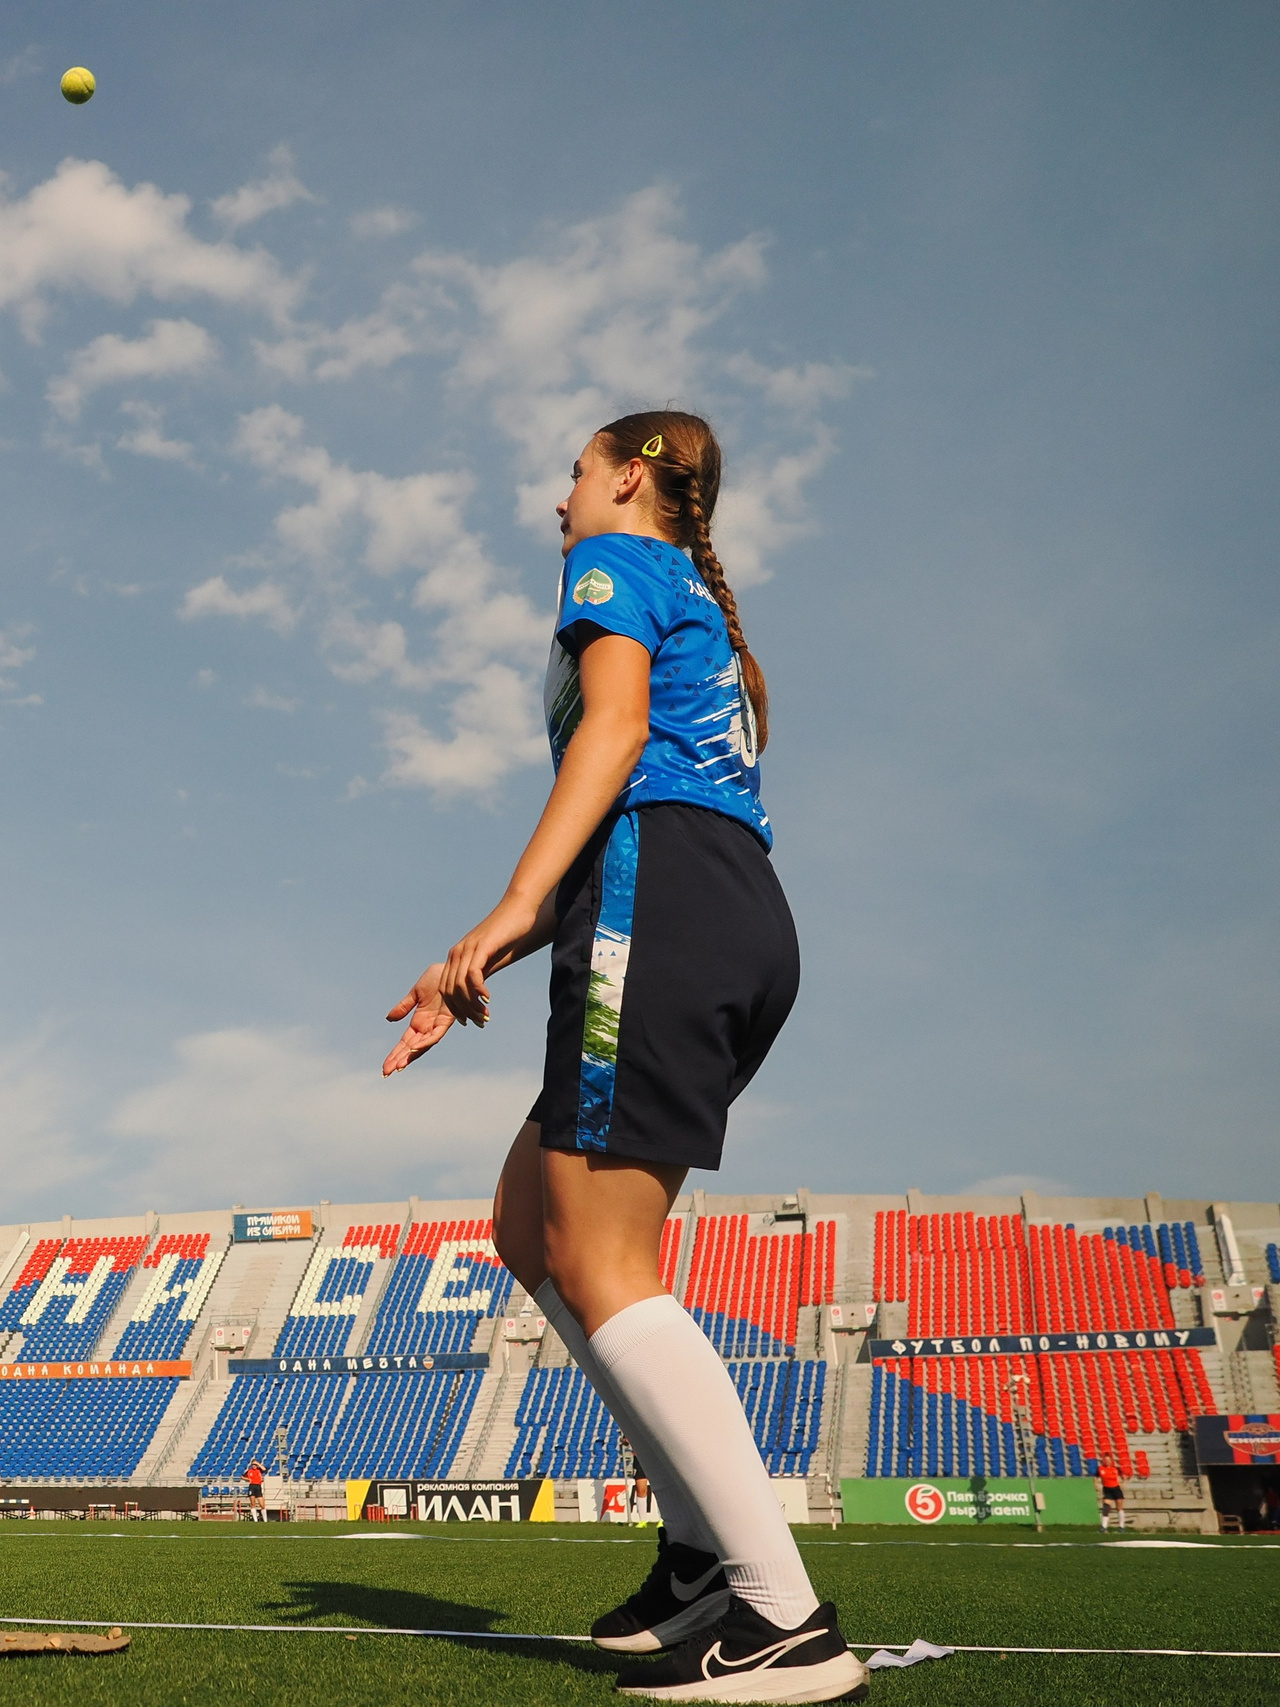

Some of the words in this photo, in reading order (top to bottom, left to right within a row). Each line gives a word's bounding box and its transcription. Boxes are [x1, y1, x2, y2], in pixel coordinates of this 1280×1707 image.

[246, 1214, 300, 1226] ПРЯМИКОМ
[246, 1226, 261, 1237] ИЗ
[262, 1224, 301, 1236] СИБИРИ
[891, 1338, 1001, 1355] ФУТБОЛ
[1019, 1331, 1191, 1351] ПО-НОВОМУ
[1, 1365, 49, 1377] ОДНА
[63, 1363, 154, 1375] КОМАНДА
[279, 1358, 331, 1373] ОДНА
[346, 1356, 417, 1370] МЕЧТА
[417, 1483, 469, 1493] рекламная
[471, 1483, 519, 1492] компания
[916, 1488, 936, 1516] 5
[946, 1490, 1028, 1505] Пятёрочка
[417, 1495, 521, 1522] ИЛАН
[949, 1505, 1030, 1519] выручает!
